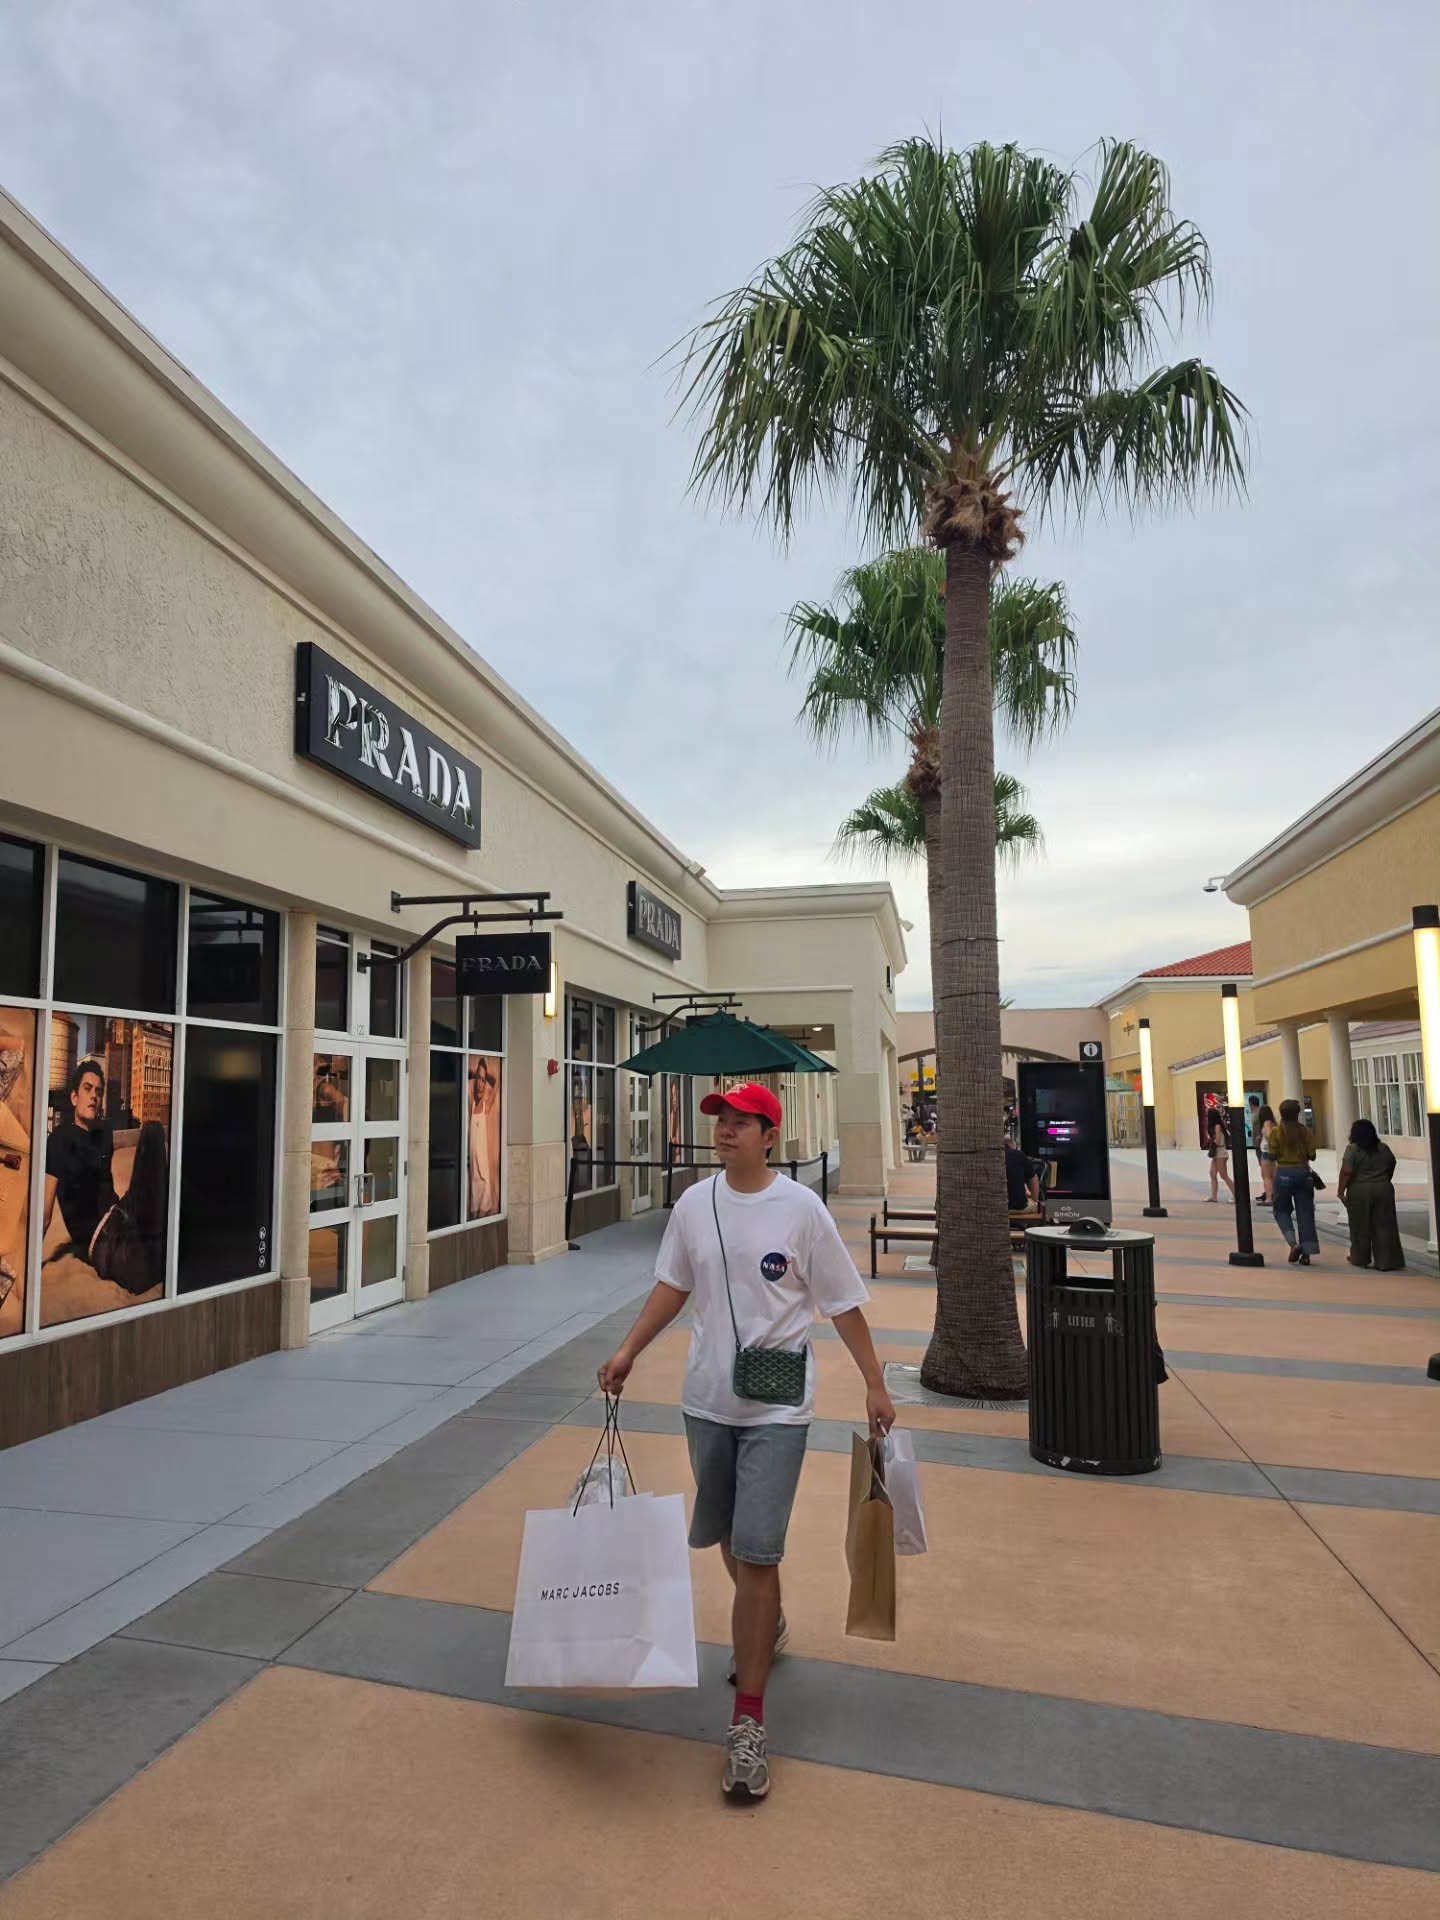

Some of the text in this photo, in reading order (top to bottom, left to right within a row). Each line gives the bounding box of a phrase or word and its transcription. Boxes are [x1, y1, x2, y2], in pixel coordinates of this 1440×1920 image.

[324, 673, 475, 830] PRADA
[638, 894, 680, 951] PRADA
[462, 955, 543, 973] PRADA
[1067, 1314, 1096, 1328] LITTER
[540, 1582, 620, 1601] MARC JACOBS
